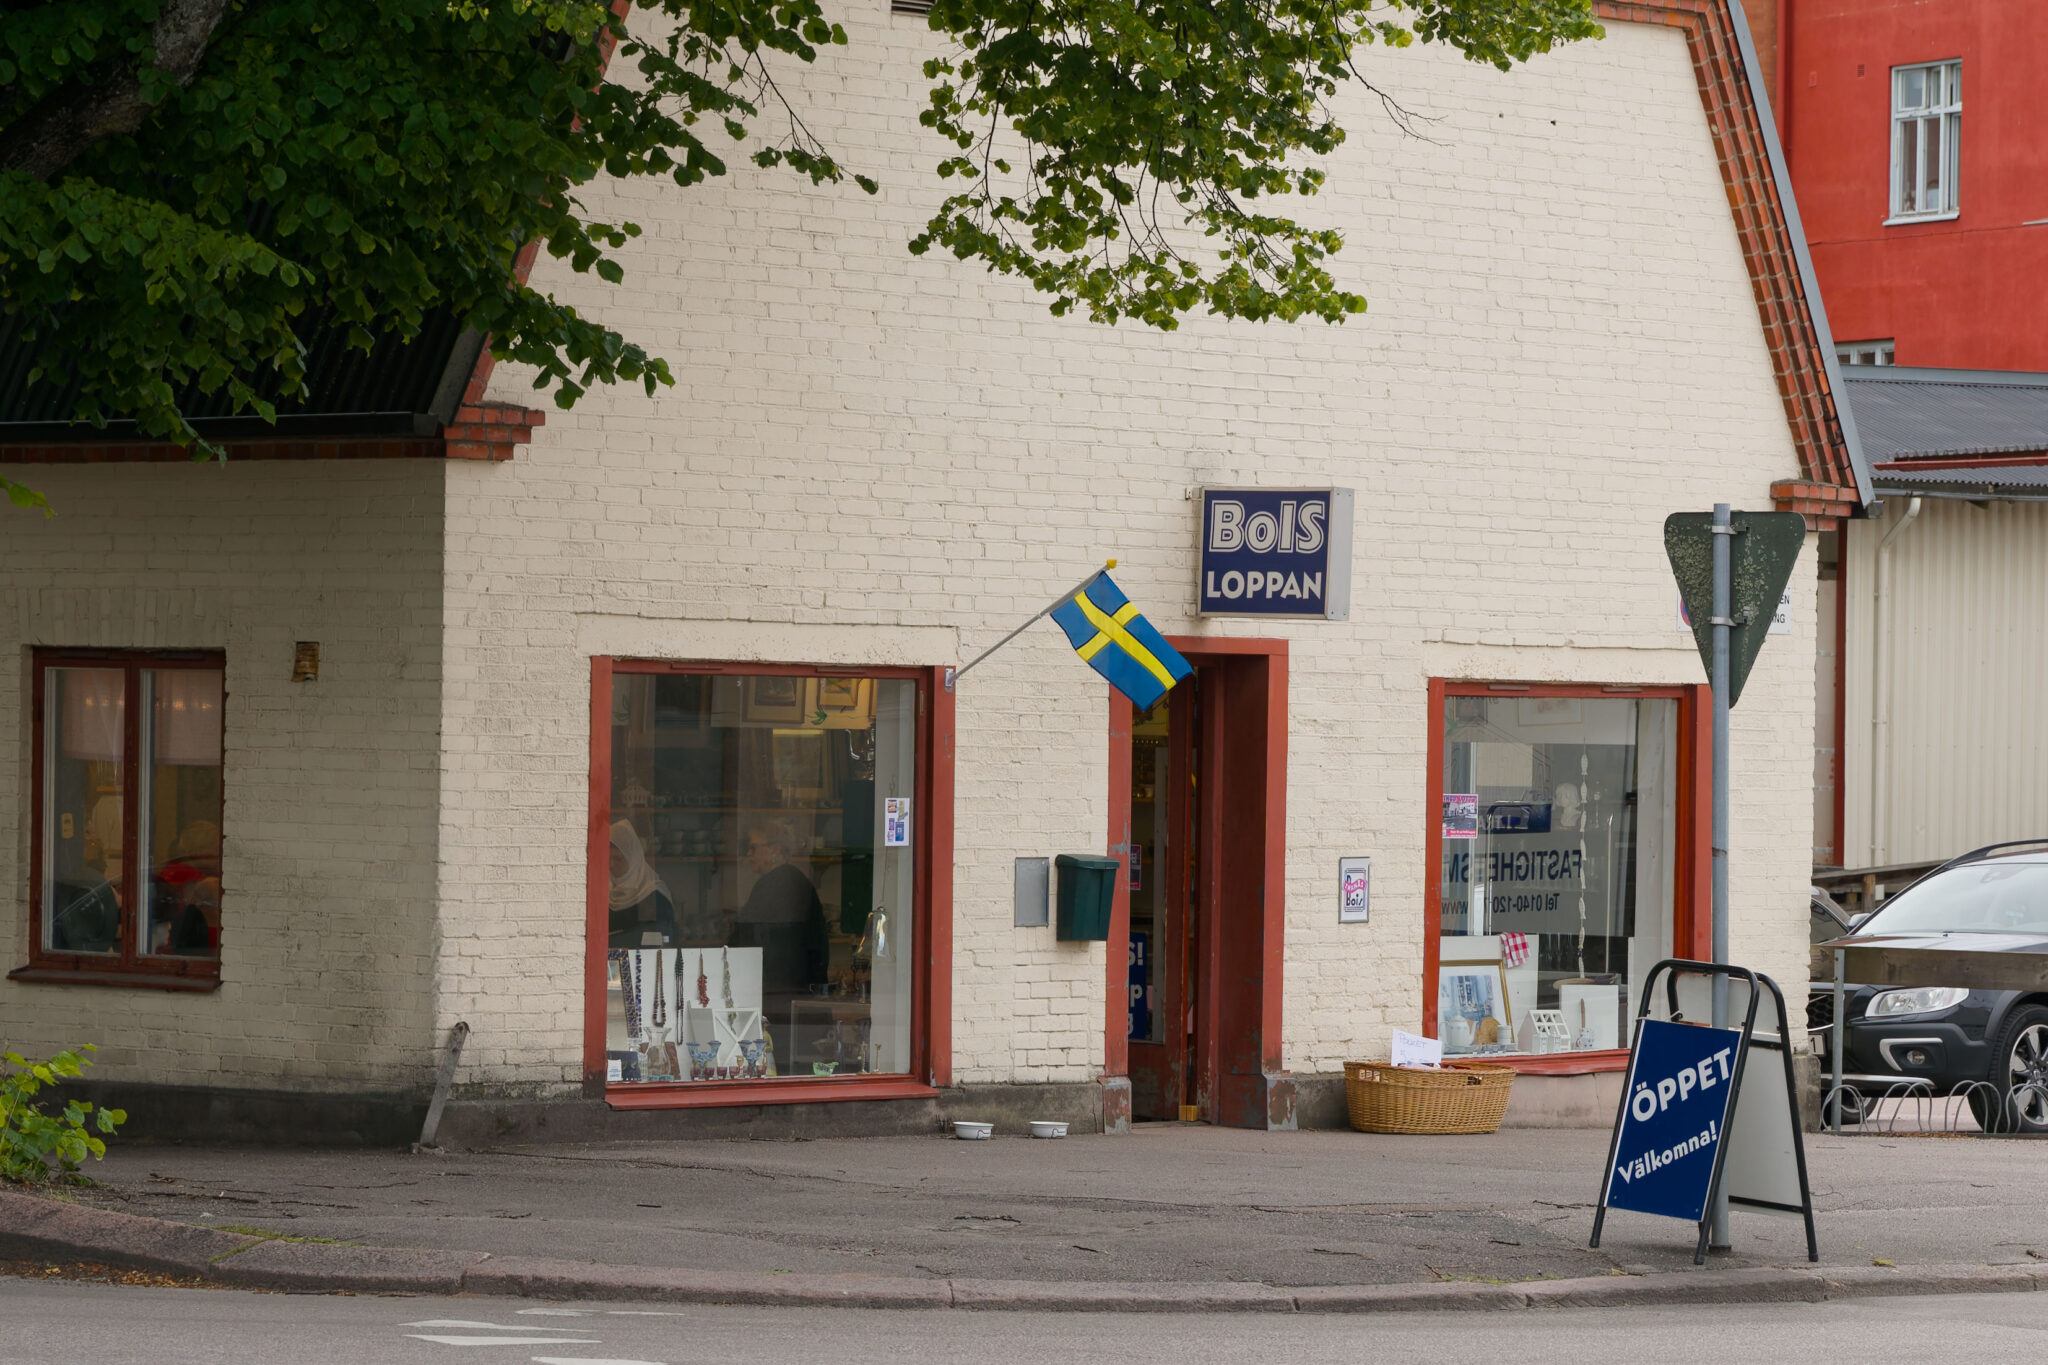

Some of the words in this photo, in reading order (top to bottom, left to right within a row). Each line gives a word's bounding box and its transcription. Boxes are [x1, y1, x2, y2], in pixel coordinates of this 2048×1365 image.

[1206, 570, 1322, 600] LOPPAN
[1632, 1047, 1731, 1122] ÖPPET
[1617, 1120, 1718, 1184] Välkomna!
